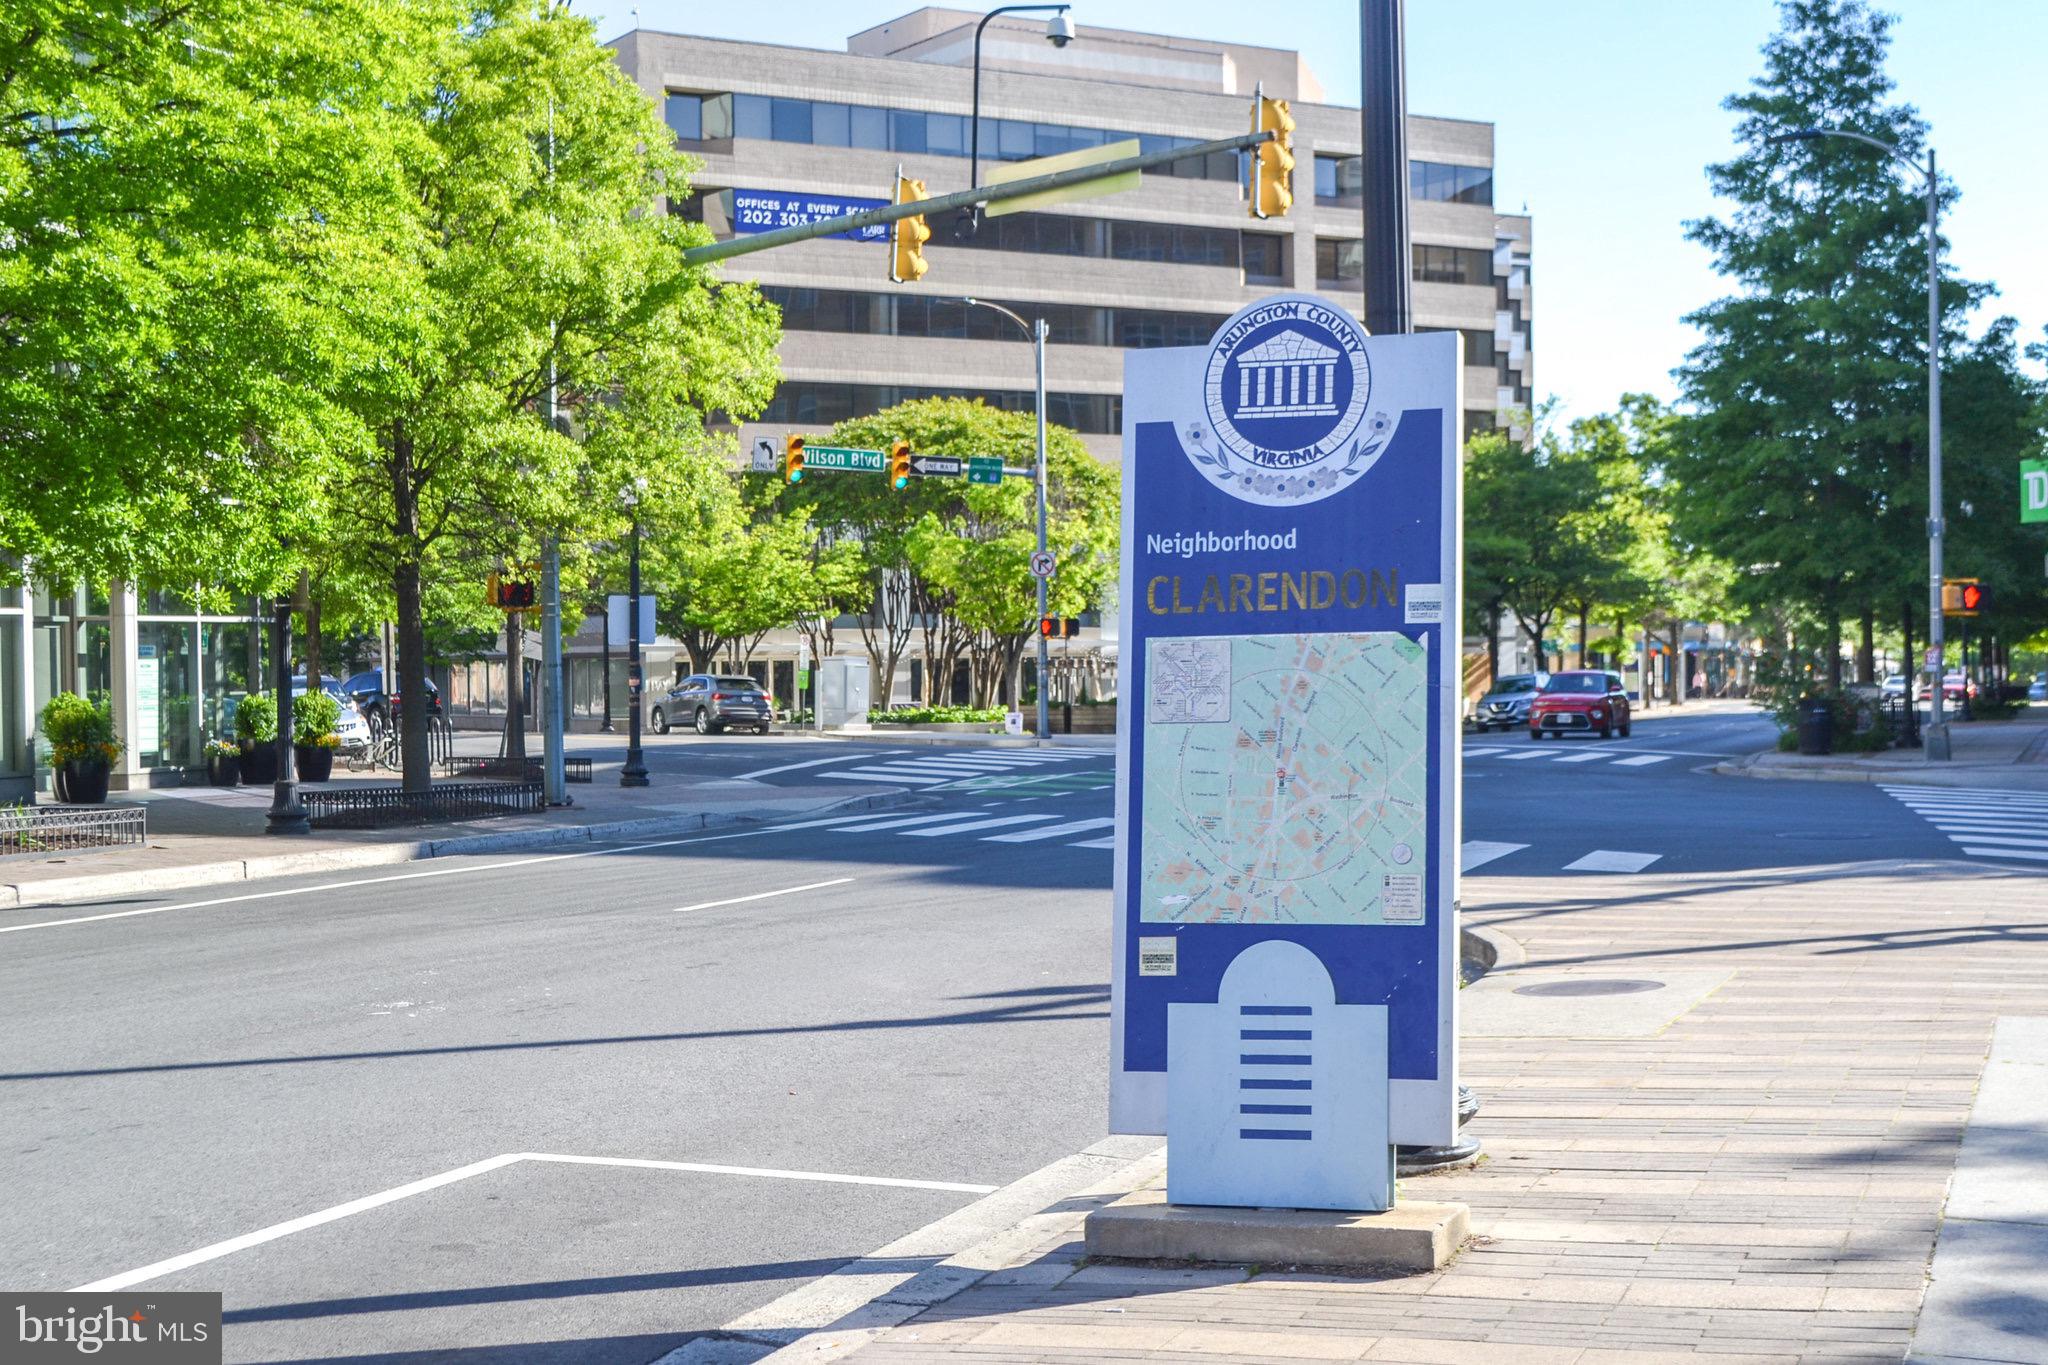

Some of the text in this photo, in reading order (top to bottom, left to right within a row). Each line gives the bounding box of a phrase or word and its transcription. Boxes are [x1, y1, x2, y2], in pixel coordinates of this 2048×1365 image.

[736, 197, 780, 211] OFFICES
[786, 201, 800, 212] AT
[807, 203, 840, 215] EVERY
[1216, 304, 1363, 359] ARLINGTON COUNTY
[755, 462, 774, 470] ONLY
[851, 452, 880, 468] Blvd
[1253, 444, 1325, 466] VIRGINIA
[1147, 528, 1297, 559] Neighborhood
[1147, 568, 1399, 615] CLARENDON
